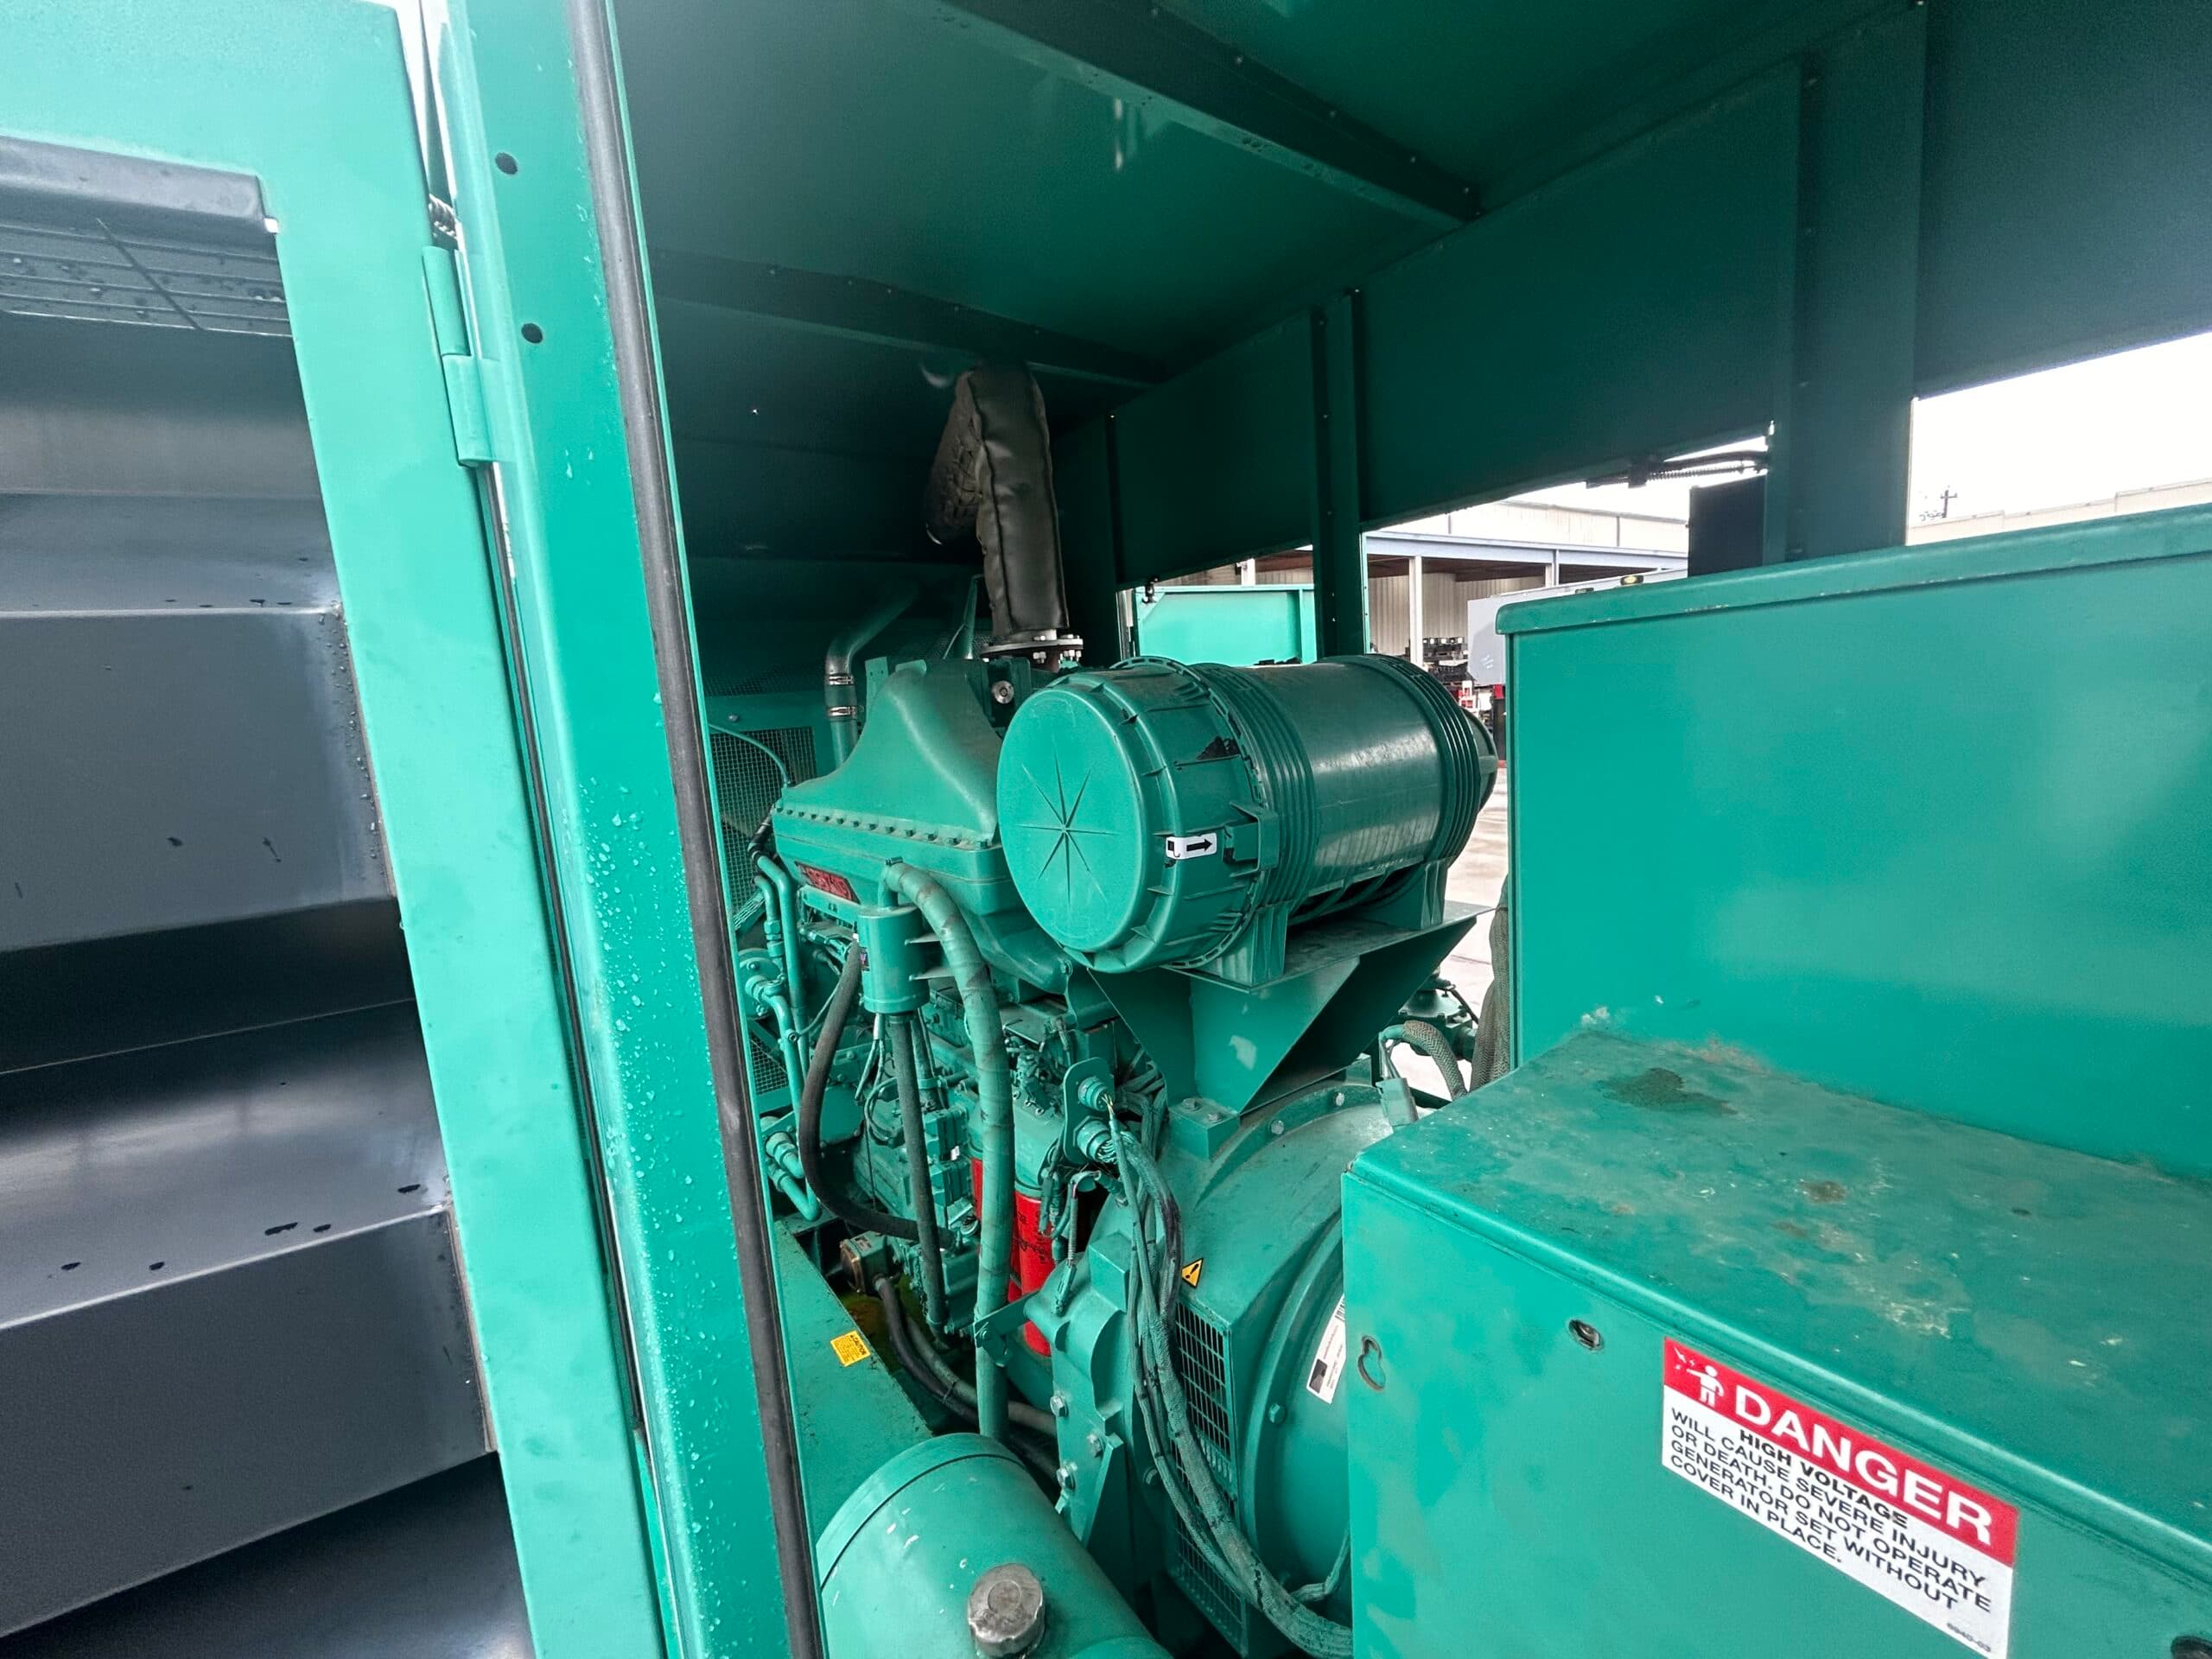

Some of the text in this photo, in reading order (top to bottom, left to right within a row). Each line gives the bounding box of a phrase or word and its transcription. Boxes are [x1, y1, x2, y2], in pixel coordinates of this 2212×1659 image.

[1671, 1407, 1986, 1588] WILL CAUSE SEVERE INJURY
[1671, 1455, 1842, 1563] COVER IN PLACE.
[1671, 1440, 1958, 1610] GENERATOR SET WITHOUT
[1672, 1425, 1992, 1613] OR DEATH. DO NOT OPERATE
[1735, 1384, 1993, 1547] DANGER
[1739, 1429, 1909, 1530] HIGH VOLTAGE
